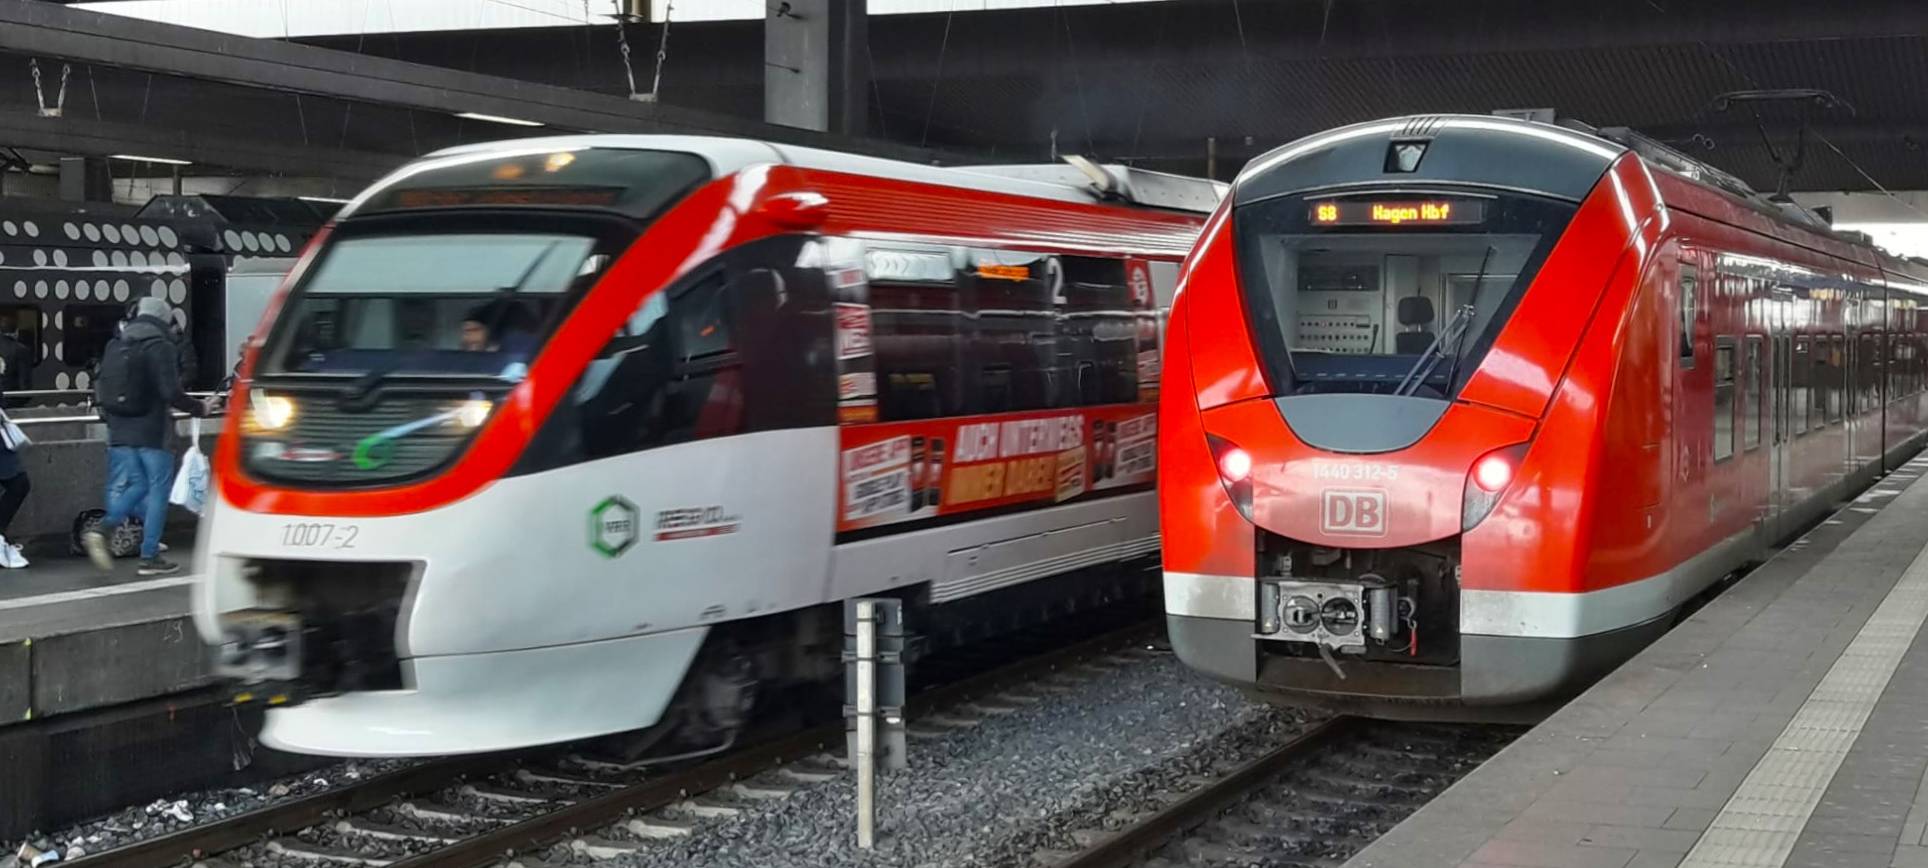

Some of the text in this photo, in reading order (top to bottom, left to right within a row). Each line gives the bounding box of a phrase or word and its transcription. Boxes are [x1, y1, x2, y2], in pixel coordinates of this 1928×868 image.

[1318, 203, 1449, 224] S8 Hagen Hbf
[1047, 257, 1068, 304] 2
[1312, 463, 1350, 480] 1440
[1325, 492, 1384, 532] DB
